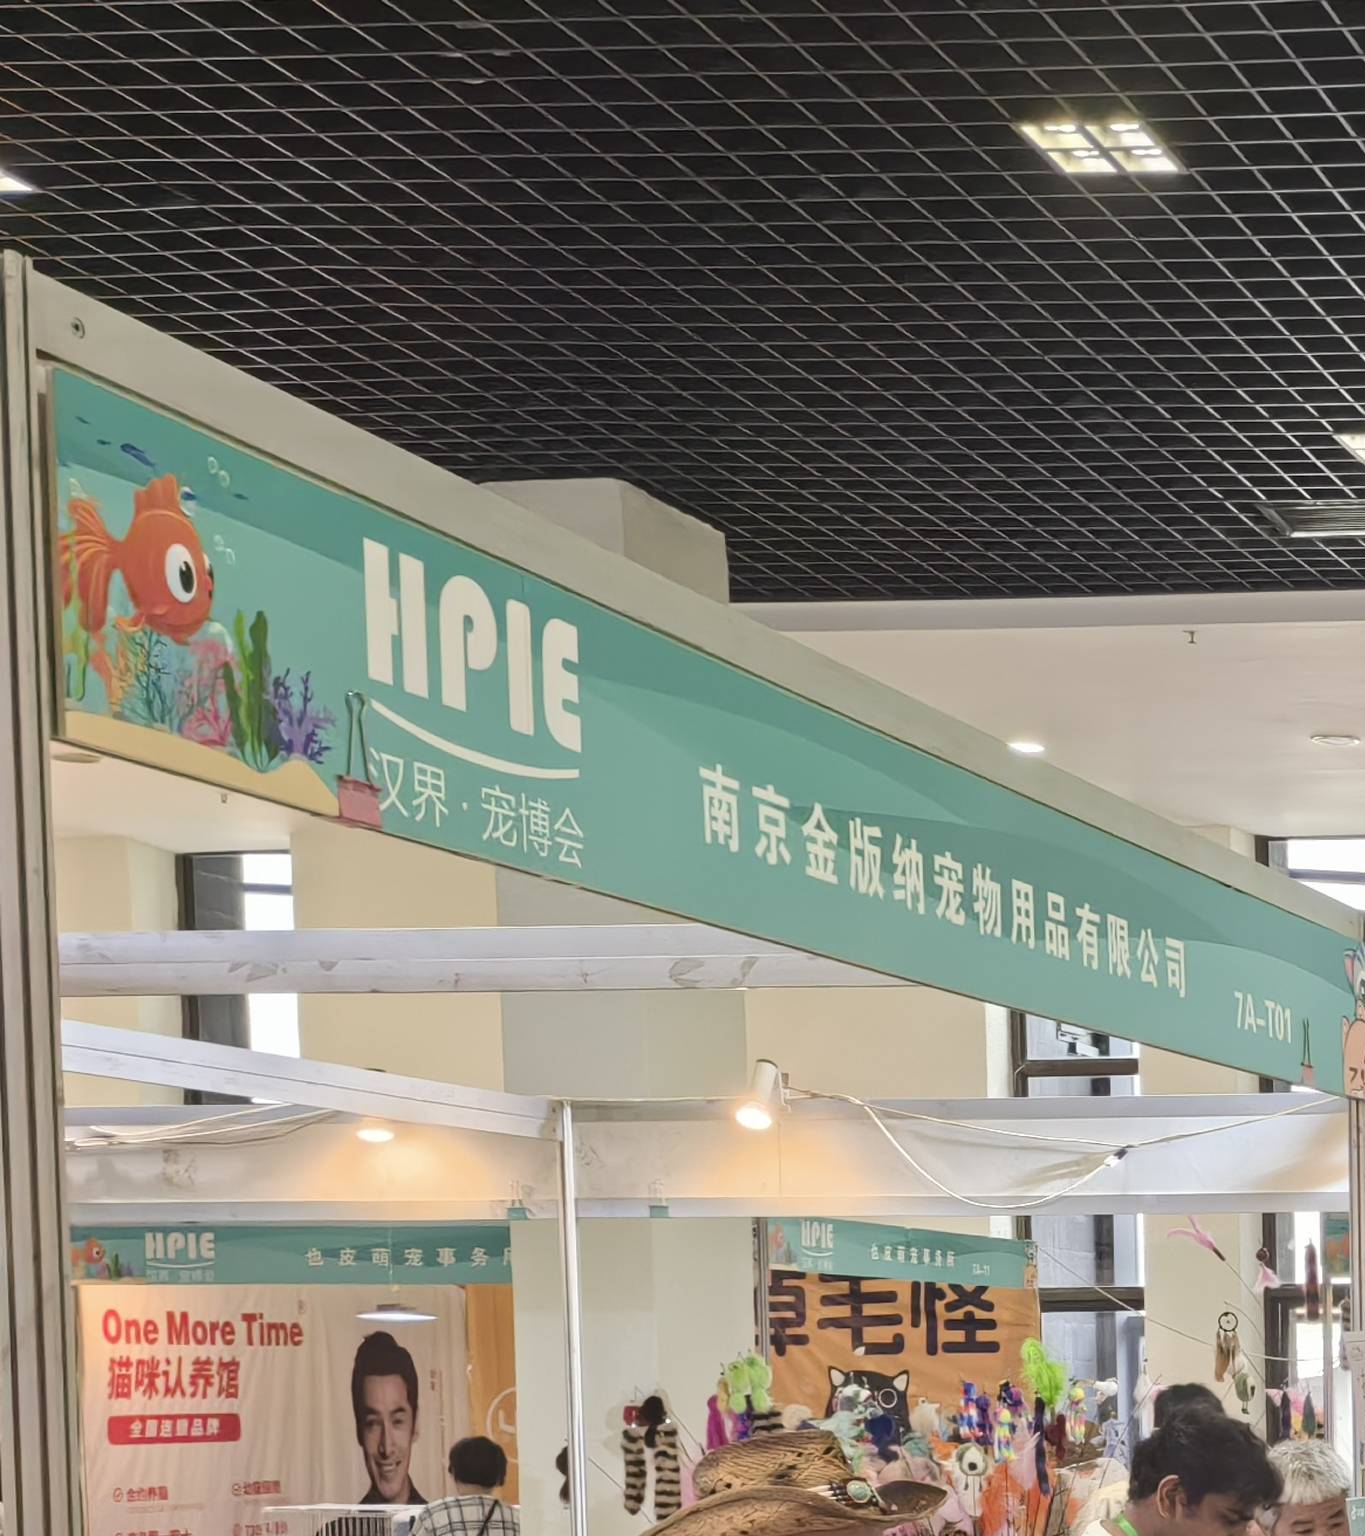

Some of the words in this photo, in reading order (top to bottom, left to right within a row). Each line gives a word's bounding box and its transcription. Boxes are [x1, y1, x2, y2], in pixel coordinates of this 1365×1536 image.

[363, 537, 583, 753] HPIE
[699, 763, 1187, 998] 南京金版纳宠物用品有限公司
[1234, 990, 1292, 1044] 7A-T01
[145, 1232, 215, 1260] HPIE
[102, 1309, 159, 1345] One
[166, 1310, 236, 1346] More
[241, 1312, 304, 1347] Time
[108, 1355, 240, 1399] 猫咪认养馆
